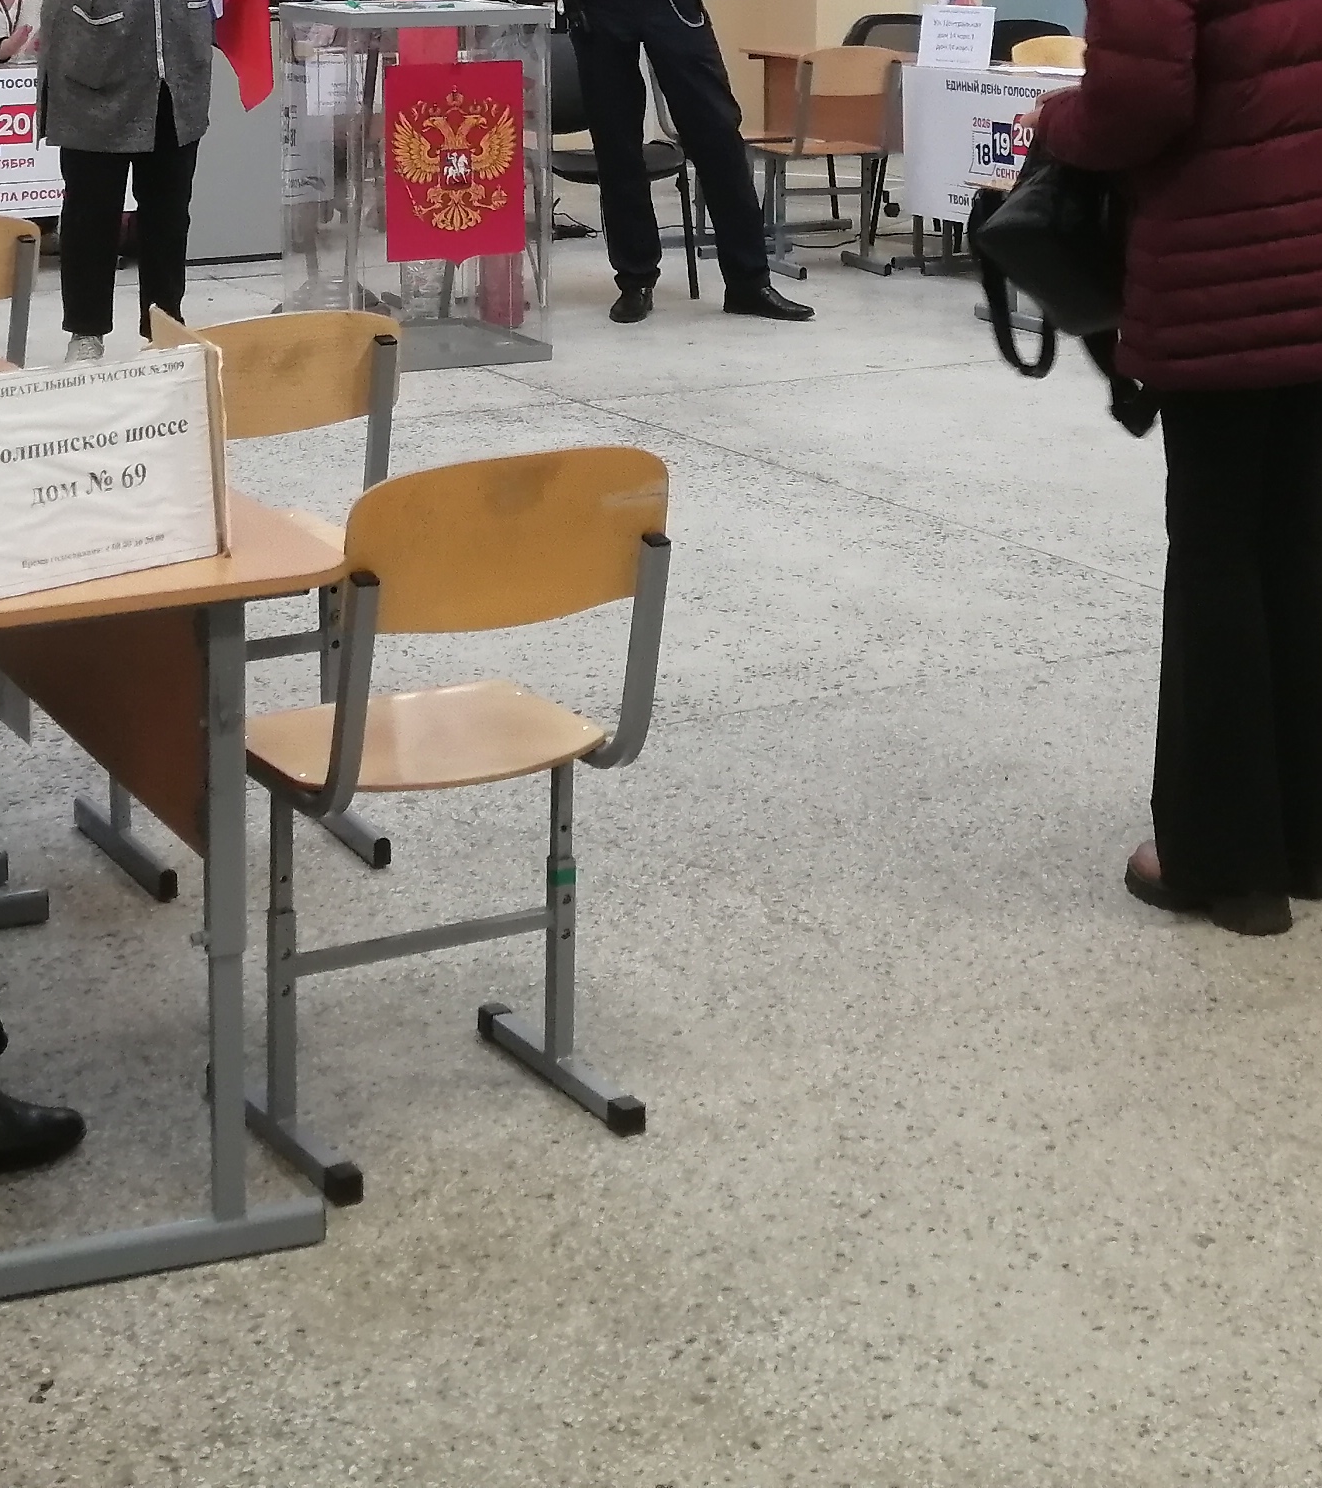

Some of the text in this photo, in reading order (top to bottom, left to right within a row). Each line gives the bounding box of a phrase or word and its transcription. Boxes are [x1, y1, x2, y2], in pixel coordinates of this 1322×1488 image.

[946, 79, 979, 93] ЕДИНЫЙ
[981, 84, 1002, 95] ДЕНЬ
[972, 117, 991, 129] 2026
[994, 132, 1010, 156] 19
[1013, 123, 1034, 148] 20
[975, 143, 991, 166] 18
[22, 188, 66, 201] РОССИ
[947, 194, 969, 207] ТВОЙ
[90, 366, 146, 385] УЧАСТОК
[162, 361, 185, 373] 2009
[125, 418, 189, 443] шоссе
[31, 463, 147, 507] дом № 69
